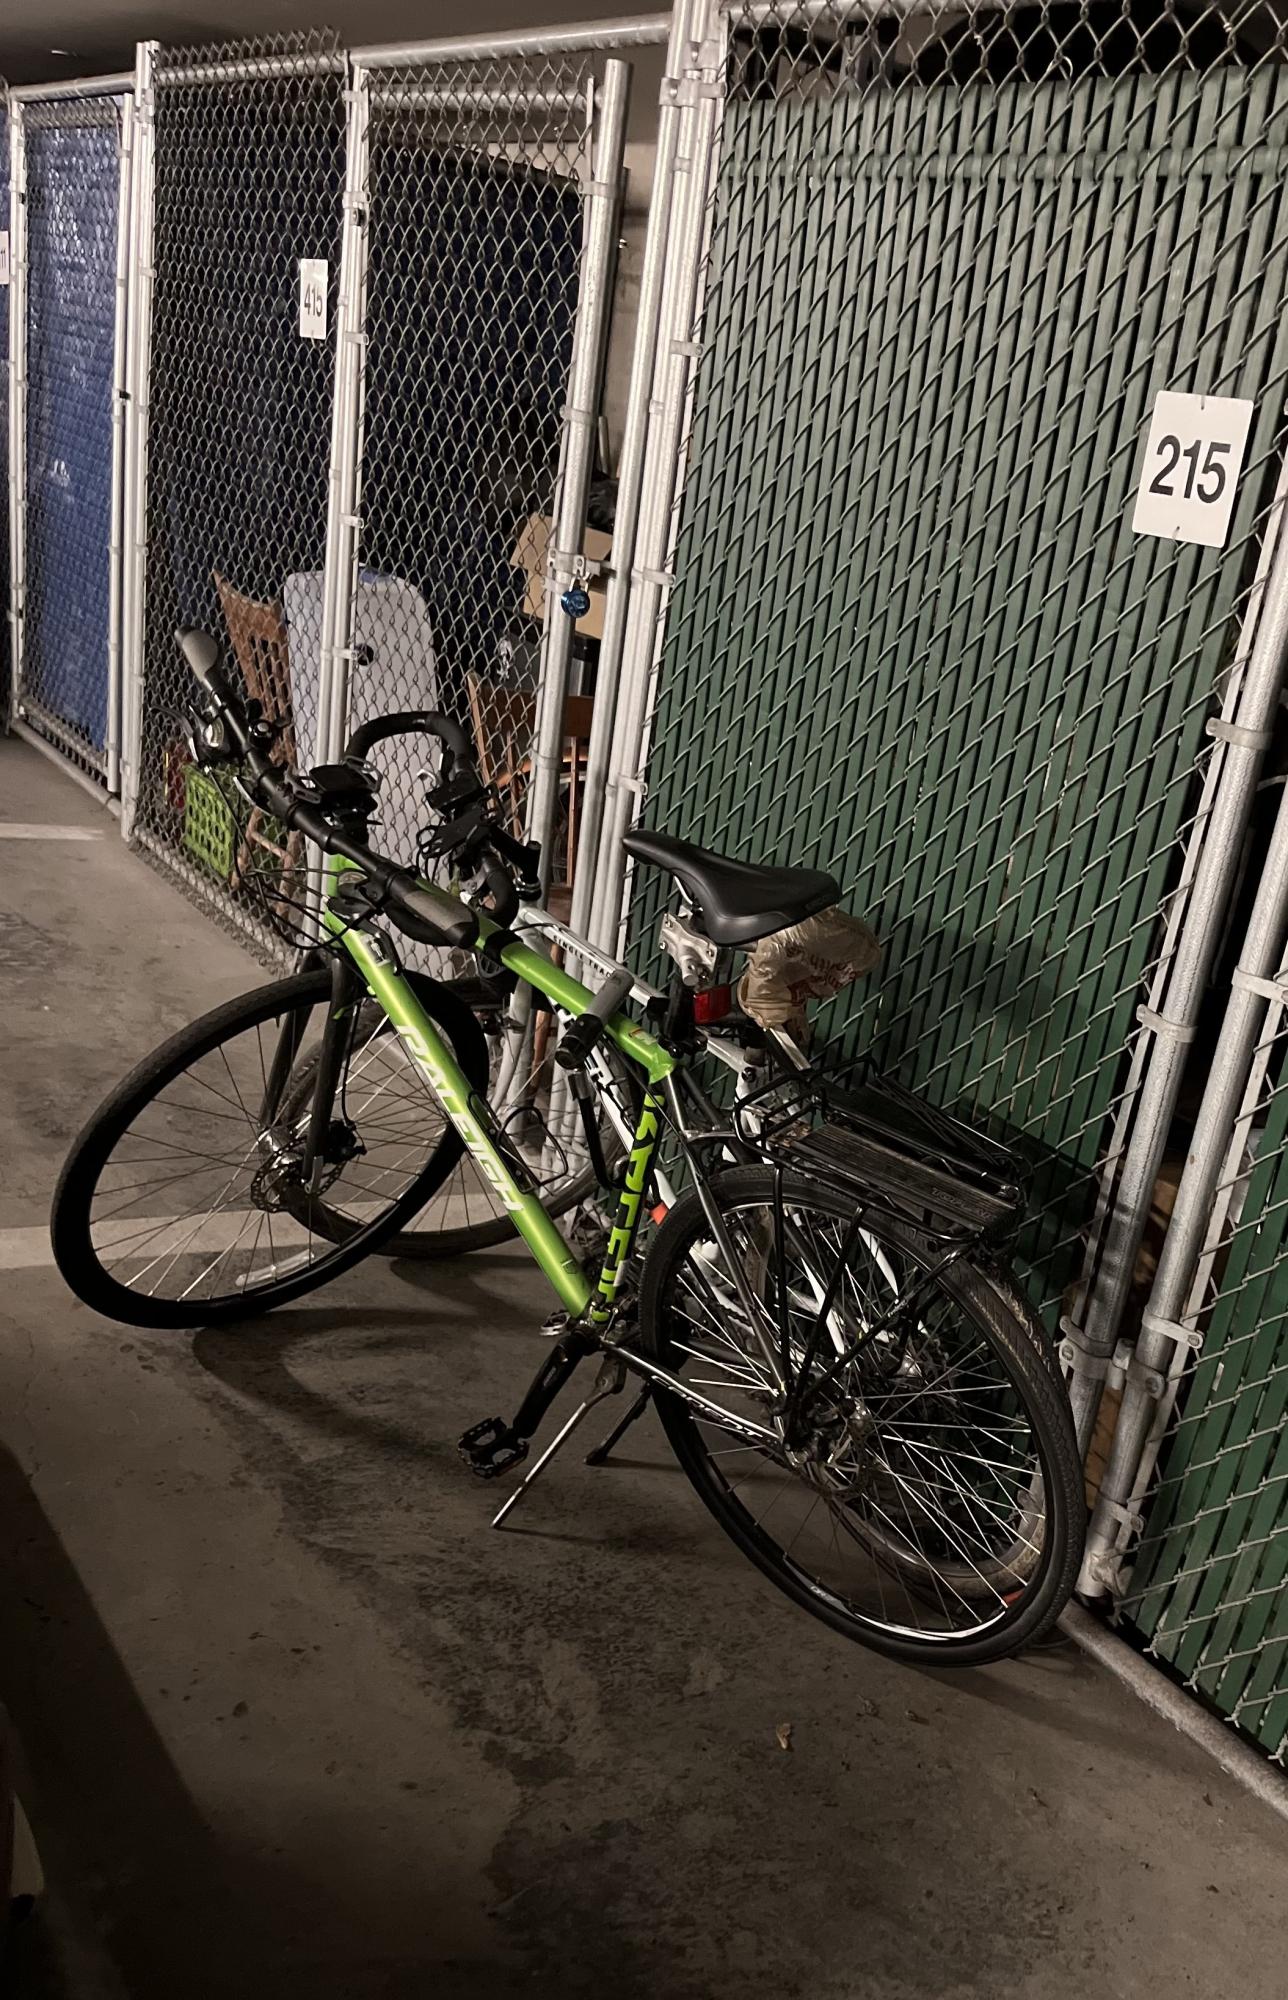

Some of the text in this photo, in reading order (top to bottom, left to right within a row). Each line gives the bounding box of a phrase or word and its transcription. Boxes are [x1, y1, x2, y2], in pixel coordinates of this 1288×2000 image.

[304, 283, 323, 318] 415
[1148, 434, 1232, 504] 215
[588, 959, 614, 978] TRAC
[396, 1025, 525, 1211] RALEIGH
